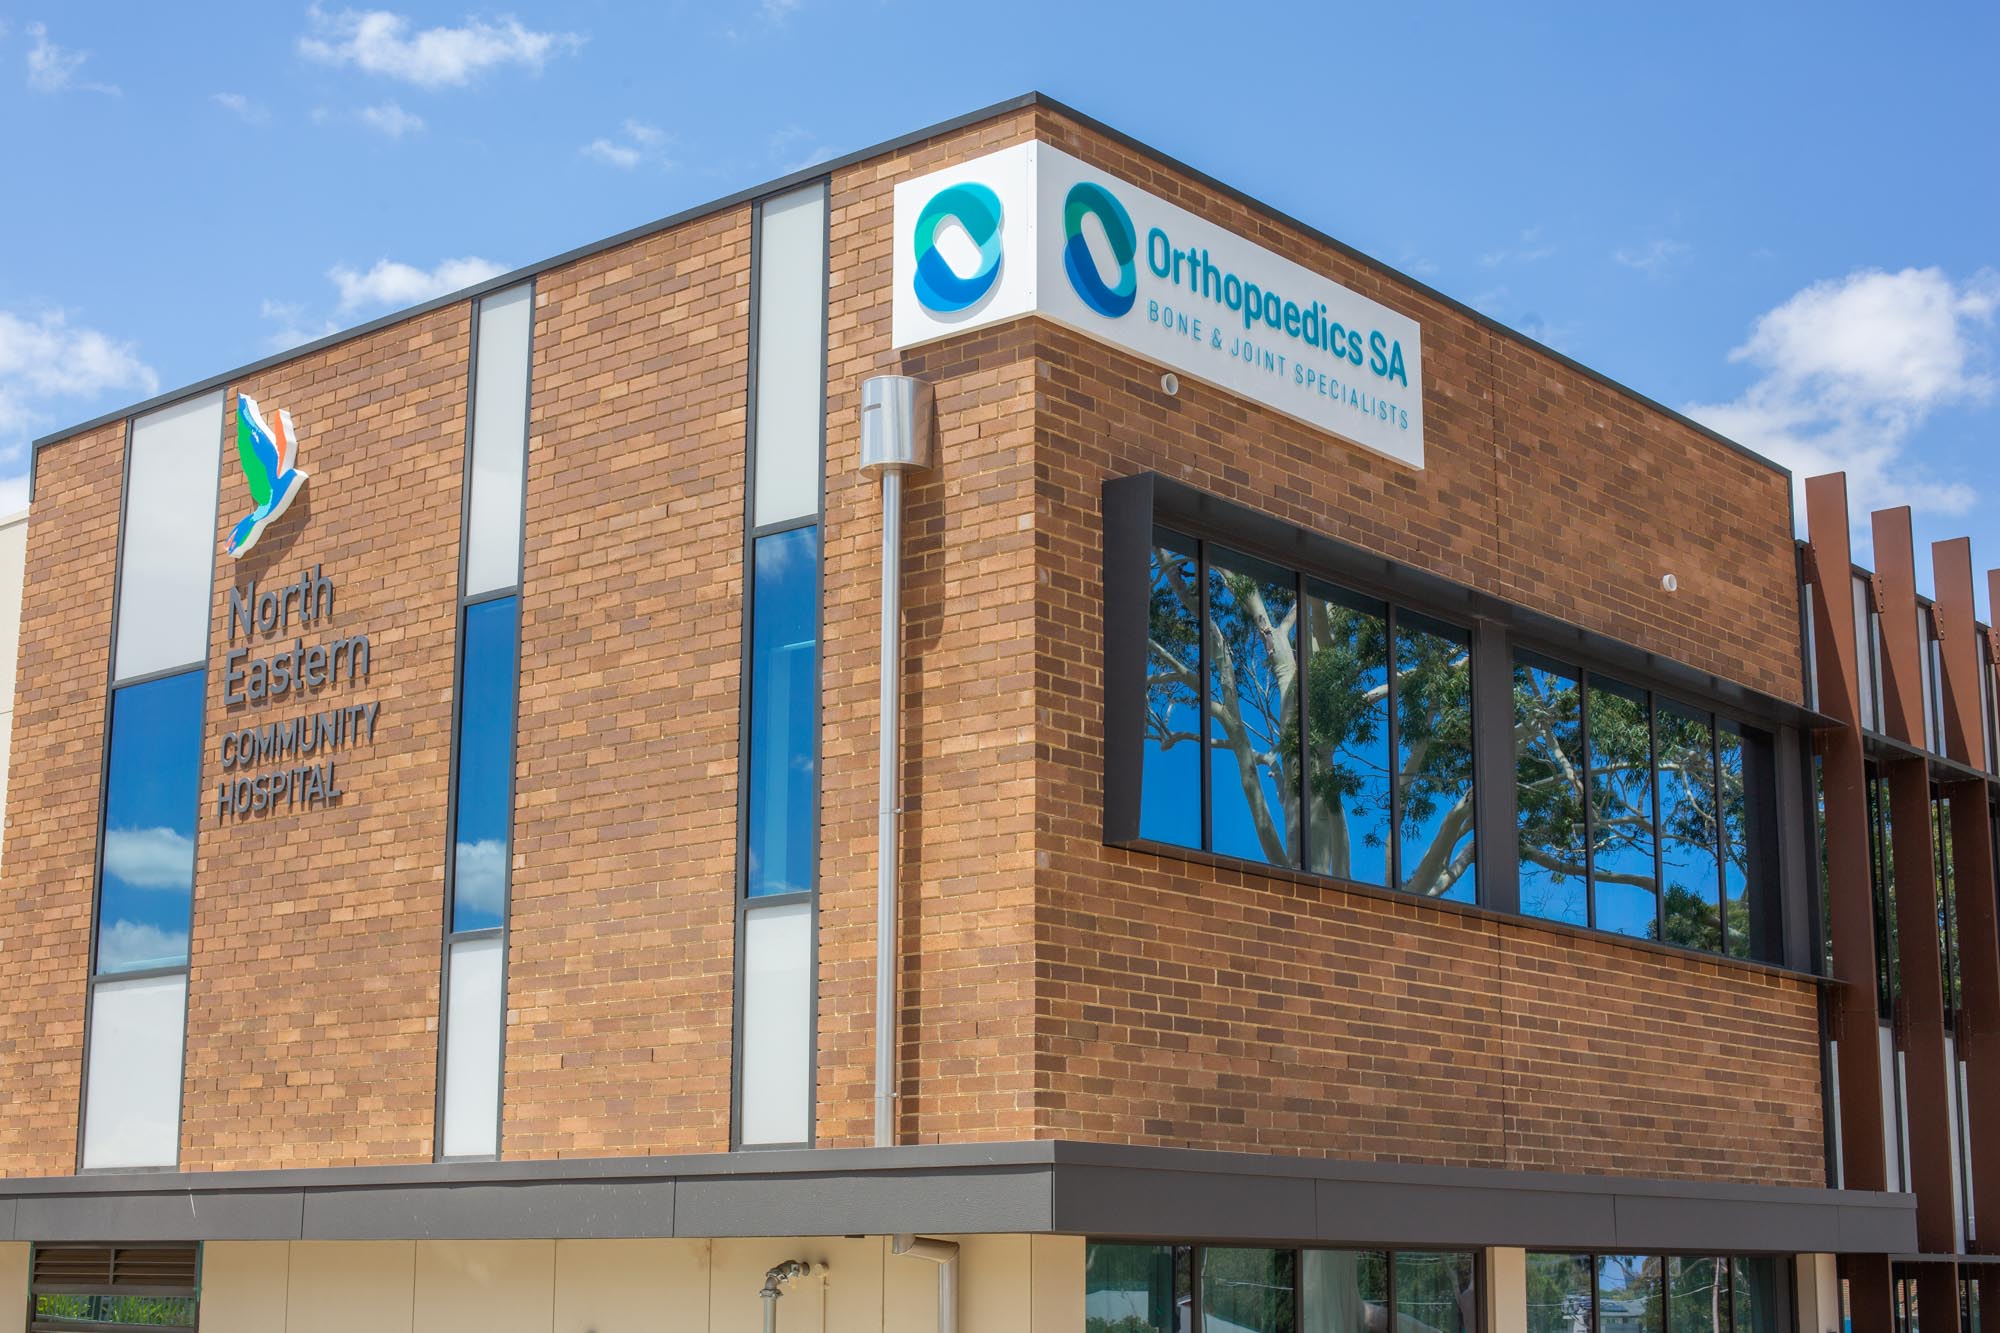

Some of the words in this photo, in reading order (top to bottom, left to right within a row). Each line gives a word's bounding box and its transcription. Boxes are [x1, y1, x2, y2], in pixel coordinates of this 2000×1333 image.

[1147, 227, 1363, 366] Orthopaedics
[1148, 300, 1202, 342] BONE
[1211, 327, 1223, 350] &
[1231, 337, 1286, 377] JOINT
[1295, 363, 1408, 430] SPECIALISTS
[227, 563, 333, 640] North
[224, 634, 370, 705] Eastern
[221, 701, 380, 768] COMMUNITY
[217, 761, 342, 818] HOSPITAL
